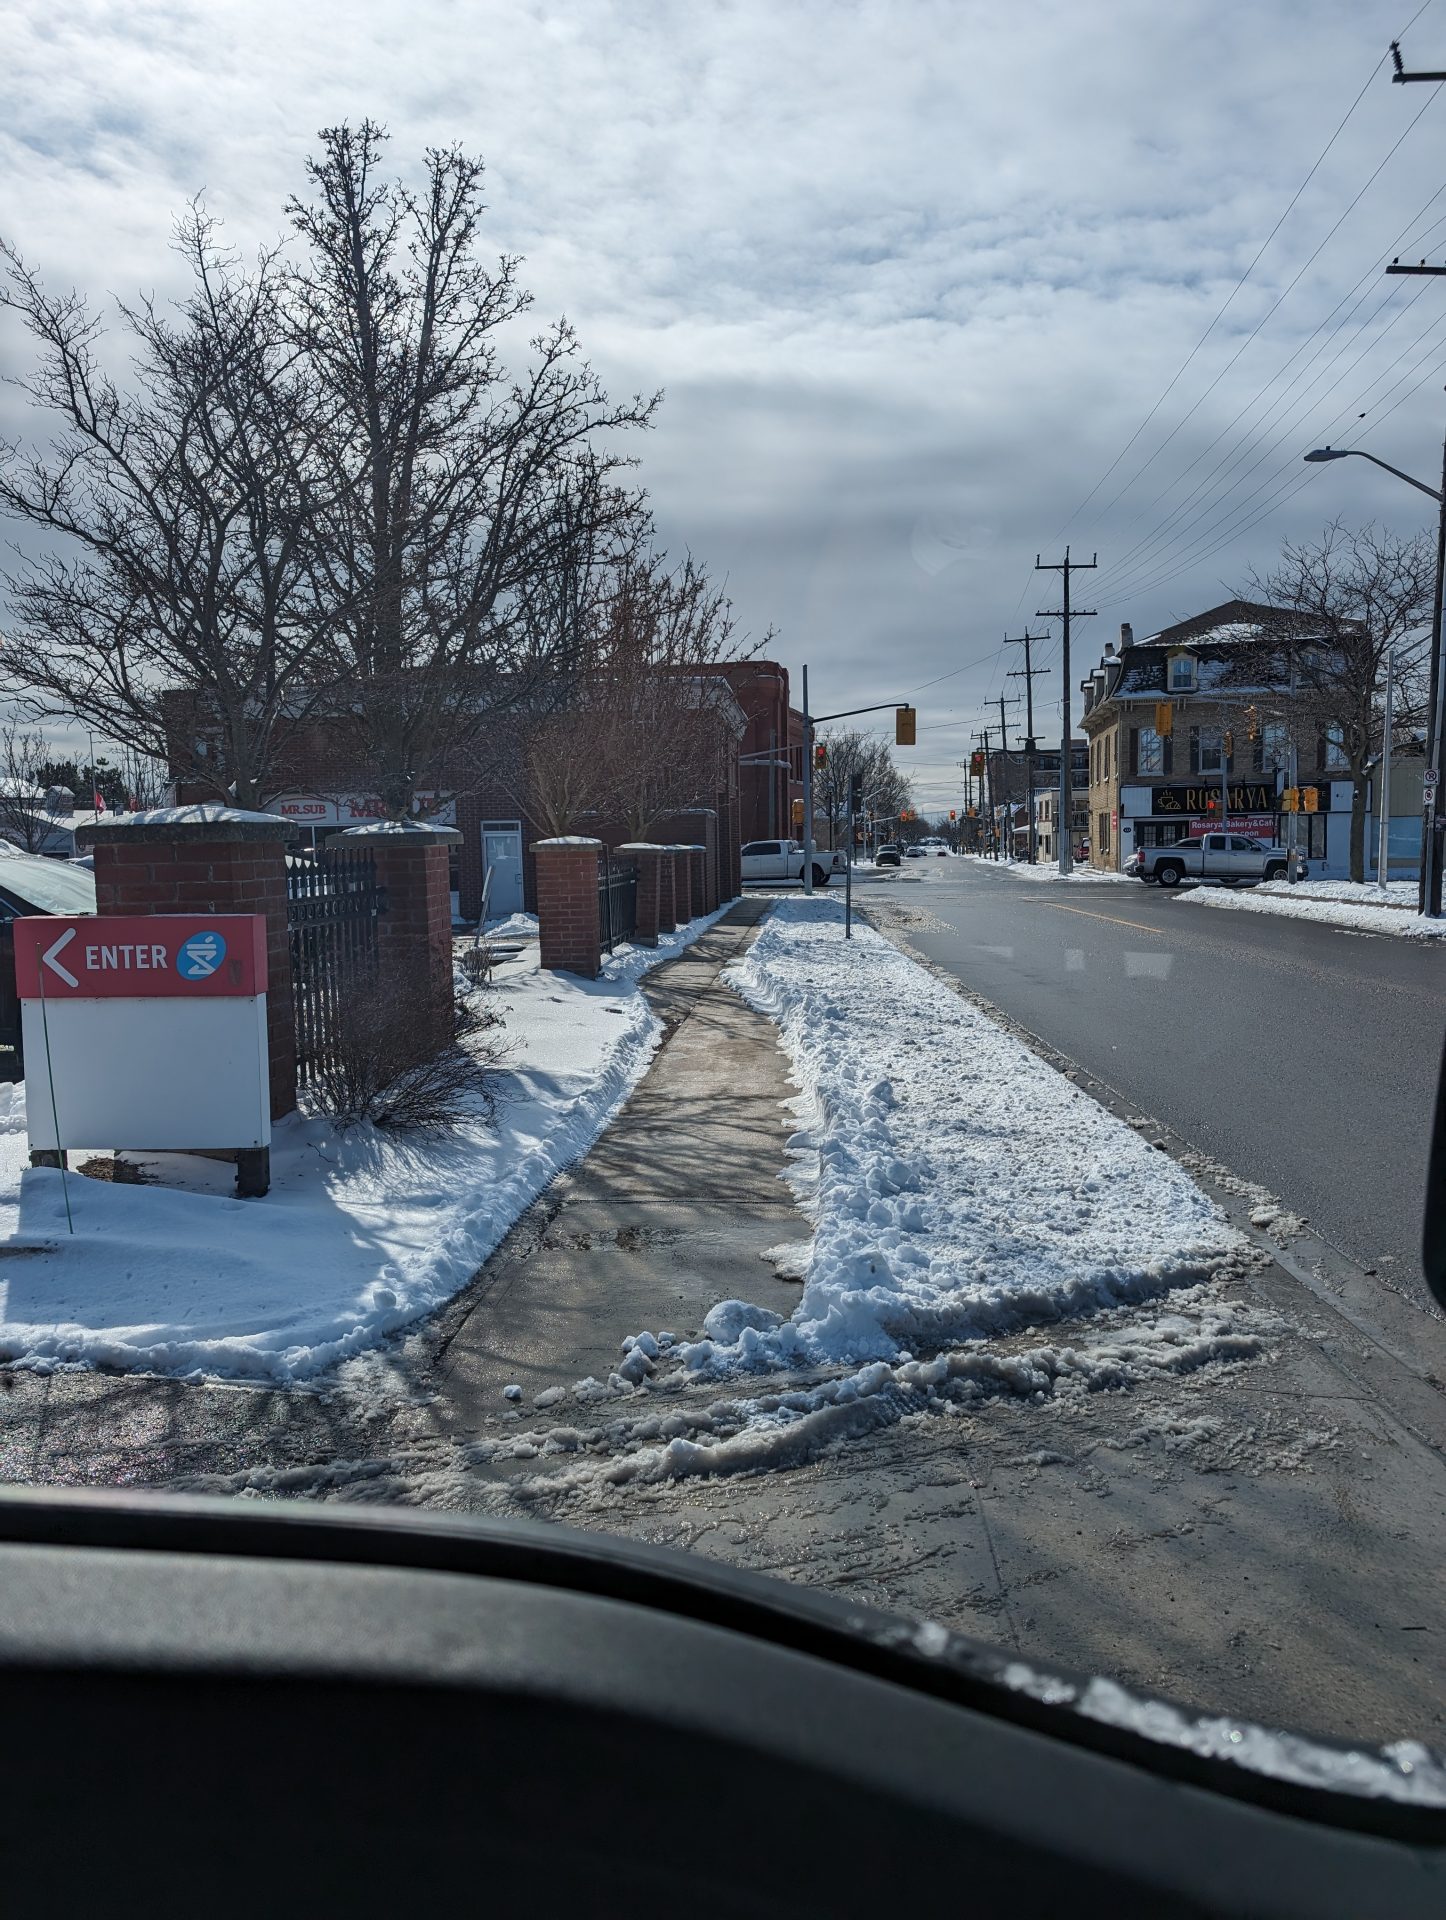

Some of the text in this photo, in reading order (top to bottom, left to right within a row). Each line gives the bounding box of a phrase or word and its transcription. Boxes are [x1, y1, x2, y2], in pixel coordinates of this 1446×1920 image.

[281, 804, 326, 815] MR.SUB
[1191, 821, 1223, 830] Rosarya
[85, 945, 168, 969] ENTER
